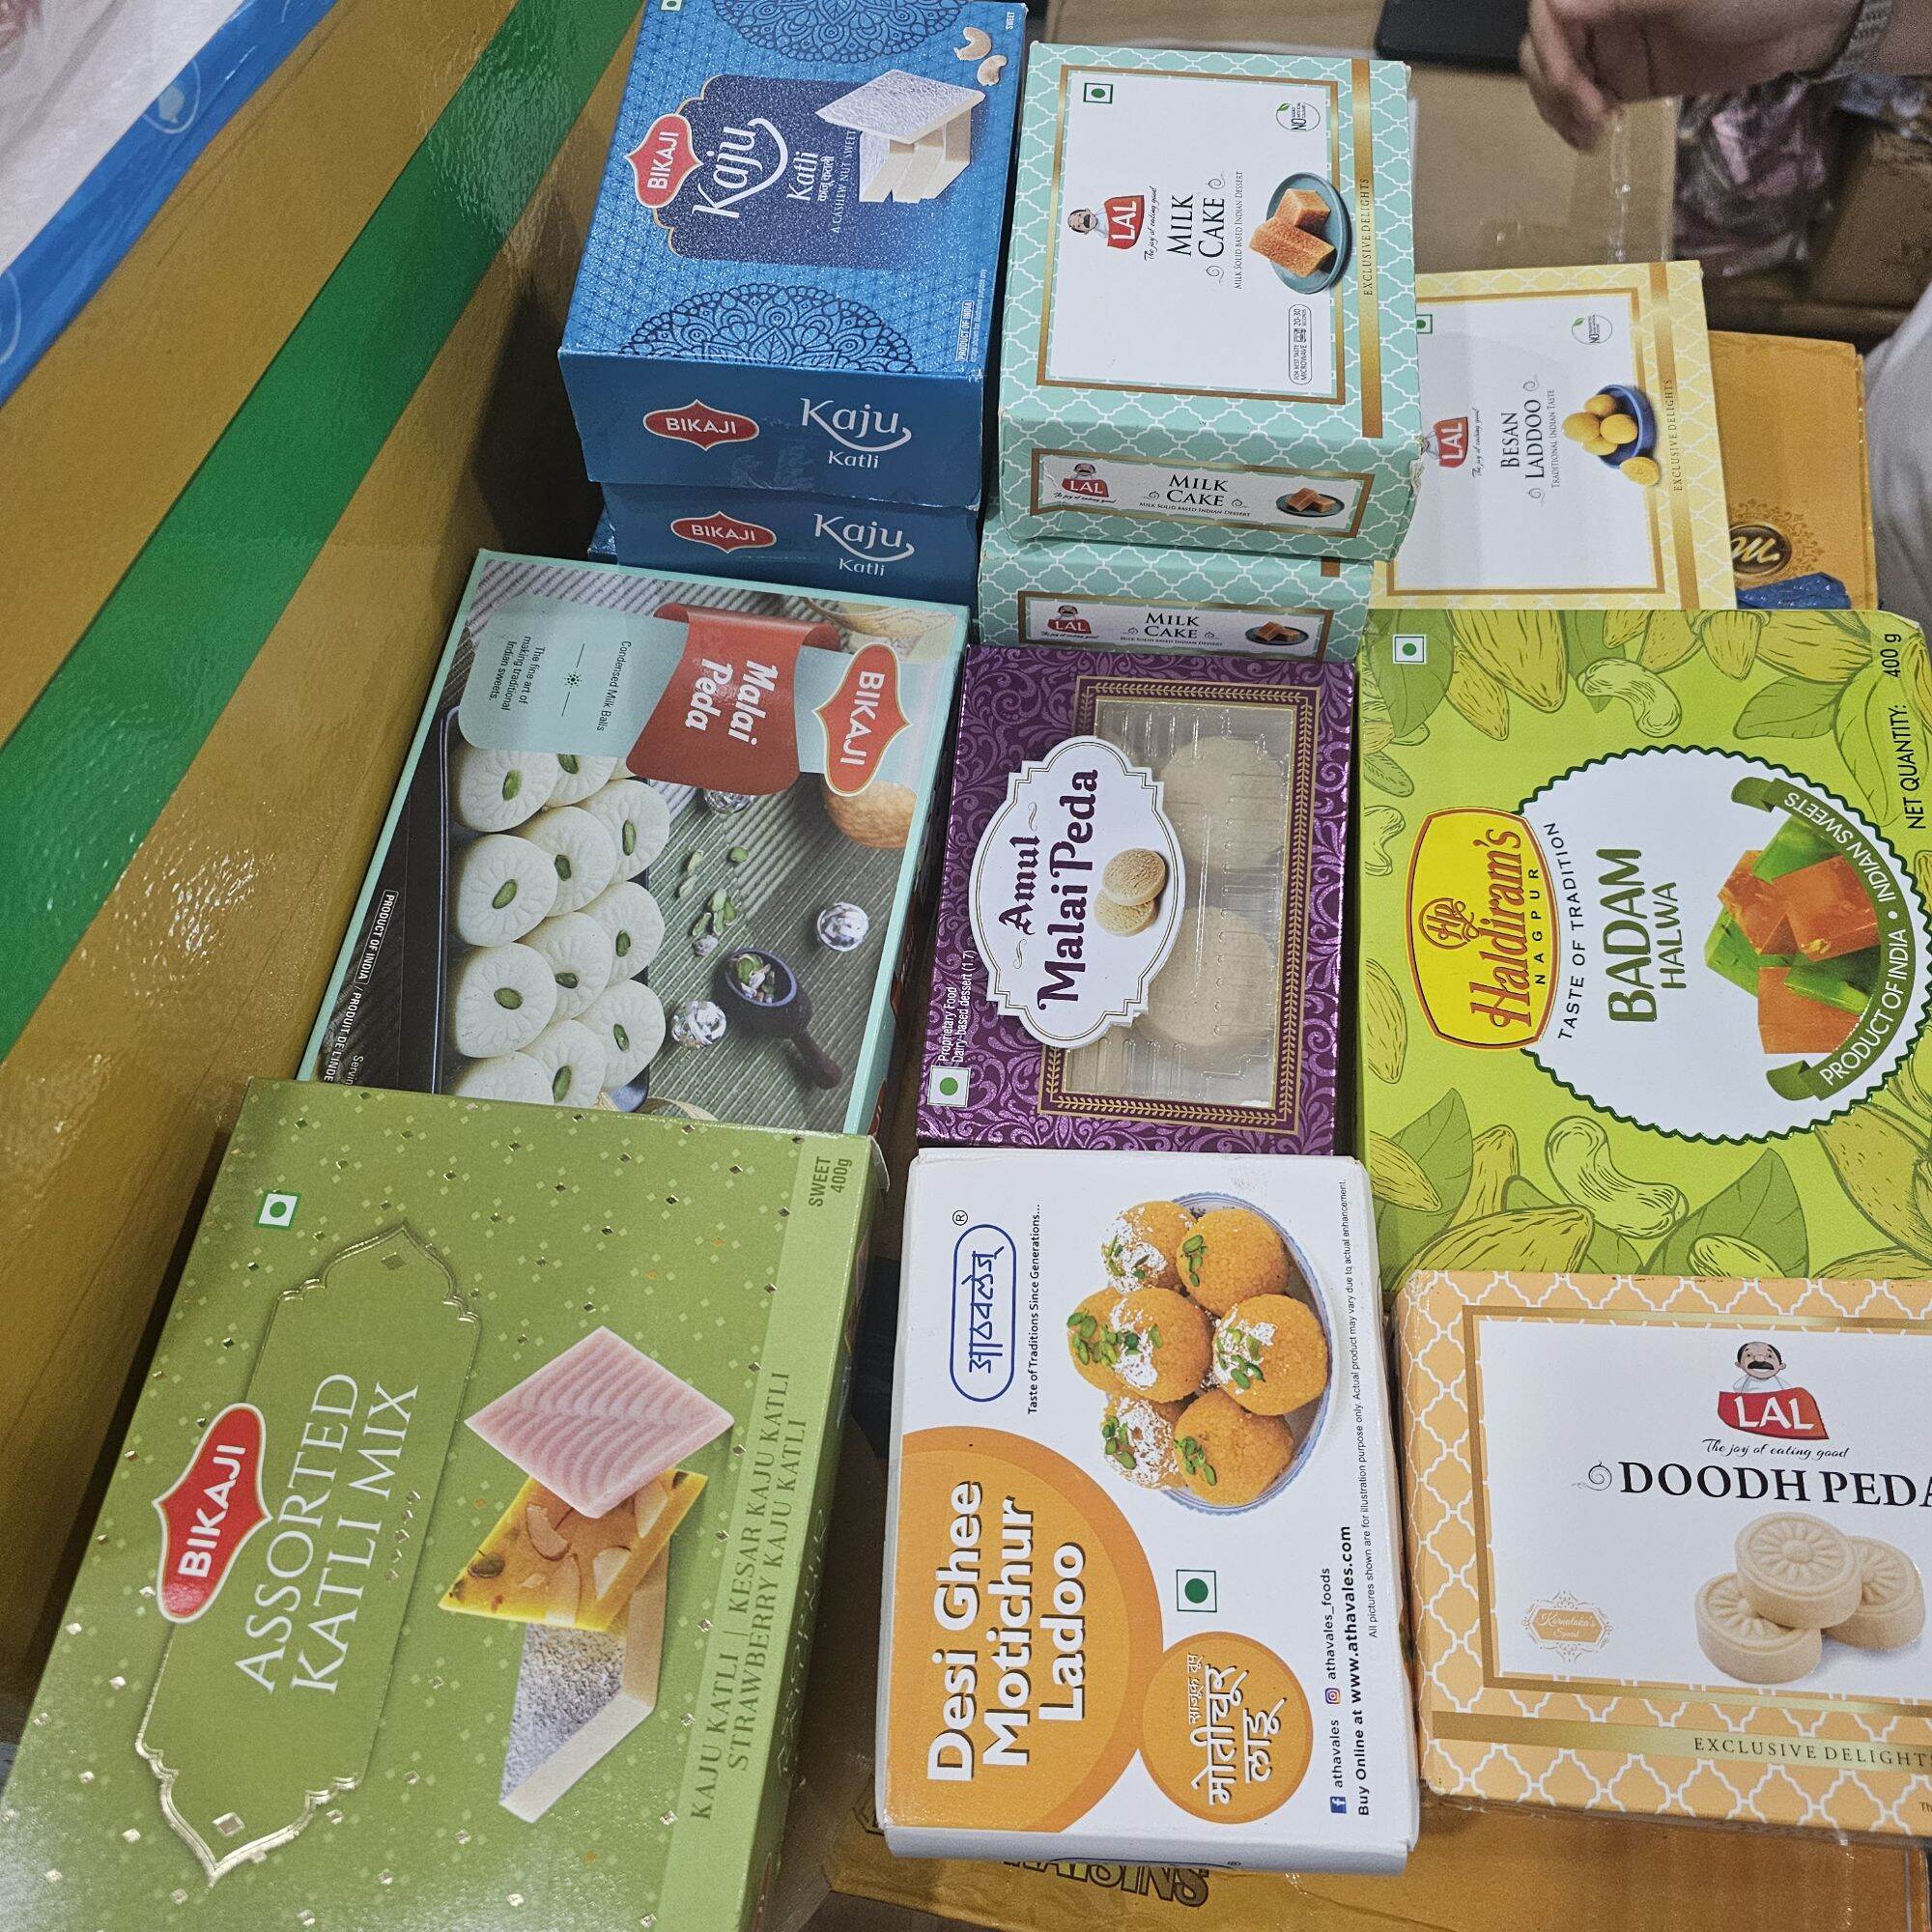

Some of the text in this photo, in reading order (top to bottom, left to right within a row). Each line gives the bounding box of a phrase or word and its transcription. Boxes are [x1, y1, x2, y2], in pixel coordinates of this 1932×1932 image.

[647, 131, 678, 189] BIKAJI
[843, 129, 856, 158] SWEET
[692, 118, 788, 218] Kaju
[786, 152, 818, 201] Katli
[840, 162, 850, 182] NUT
[833, 185, 846, 223] CASHEW
[1112, 201, 1137, 240] LAL
[1166, 194, 1193, 257] MILK
[1198, 197, 1224, 257] CAKE
[1359, 178, 1374, 296] EXCLUSIVE DELIGHTS
[962, 301, 972, 319] INDIA
[957, 330, 968, 359] PRODUCT
[666, 417, 736, 434] BIKAJI
[800, 398, 912, 452] Kaju
[1441, 423, 1463, 459] LAL
[1501, 412, 1520, 468] BESAN
[1524, 400, 1544, 478] LADDOO
[1548, 412, 1557, 439] INDIAN
[1662, 379, 1683, 491] EXCLUSIVE DELIGHTS
[829, 451, 879, 469] Katli
[1169, 473, 1229, 493] MILK
[1549, 440, 1559, 488] TRADITIONAL
[1070, 481, 1103, 495] LAL
[1167, 489, 1225, 506] CAKE
[692, 525, 755, 541] BIKAJI
[812, 514, 914, 562] Kaju
[839, 558, 885, 576] Katli
[1055, 621, 1086, 632] LAL
[1145, 626, 1198, 639] CAKE
[1146, 612, 1200, 627] MILK
[489, 641, 517, 701] Indian sweets.
[501, 636, 531, 711] making traditional
[519, 647, 546, 704] The fine art of
[1880, 634, 1901, 678] 400 g
[597, 641, 632, 730] Condensed Milk Balls
[684, 659, 732, 730] Peda
[728, 661, 778, 745] Malai
[840, 671, 885, 765] BIKAJI
[1888, 705, 1926, 829] NET QUANTITY:
[998, 836, 1040, 935] Amul
[1037, 769, 1097, 1010] Malai Peda
[373, 895, 394, 937] PRODUCT
[1468, 829, 1532, 1028] Haldiram's
[1527, 869, 1546, 984] NAGPUR
[1544, 823, 1585, 1039] TASTE OF TRADITION
[1596, 849, 1657, 1022] BADAM
[1652, 882, 1687, 989] HALWA
[1785, 792, 1909, 1086] PRODUCT OF INDIA INDIAN SWEETS
[358, 952, 375, 980] INDIA
[369, 939, 379, 951] OF
[340, 993, 361, 1034] PRODUIT
[937, 987, 956, 1062] Proprietary Food
[951, 974, 972, 1063] Dairy-based dessert
[334, 1036, 348, 1048] DE
[809, 1156, 831, 1207] SWEET
[831, 1158, 852, 1193] 400g
[1339, 1179, 1350, 1236] enhancement.
[1342, 1238, 1352, 1264] actual
[1345, 1265, 1352, 1275] to
[1028, 1204, 1040, 1414] Taste of Traditions Since Generations...
[1345, 1277, 1354, 1293] due
[1347, 1295, 1356, 1314] vary
[1349, 1316, 1357, 1335] may
[1349, 1337, 1360, 1370] product
[1350, 1372, 1360, 1400] Actual
[1735, 1396, 1814, 1430] LAL
[1355, 1426, 1367, 1463] purpose
[1702, 1438, 1849, 1461] The joy of eating good
[1358, 1464, 1368, 1513] illustration
[1618, 1461, 1809, 1502] DOODH
[178, 1445, 245, 1577] BIKAJI
[235, 1374, 357, 1693] ASSORTED
[1360, 1515, 1370, 1528] for
[291, 1381, 418, 1694] KATLI MIX
[1362, 1531, 1372, 1546] are
[1364, 1549, 1374, 1580] shown
[691, 1372, 789, 1820] KAJU KATLI KESAR KAJU KATLI
[727, 1577, 779, 1771] STRAWBERRY
[762, 1500, 792, 1568] KAJU
[777, 1419, 807, 1492] KATLI
[1366, 1584, 1378, 1623] pictures
[926, 1481, 982, 1781] Desi Ghee
[981, 1497, 1033, 1766] Motichur
[1038, 1543, 1086, 1720] Ladoo
[1368, 1625, 1378, 1638] All
[1321, 1568, 1343, 1787] athavales athavales_foods
[1339, 1526, 1370, 1816] Buy Online at www.athavales.com
[1189, 1664, 1248, 1804] मोतीचूर
[1242, 1698, 1286, 1783] लाडू
[1694, 1737, 1932, 1768] EXCLUSIVE DELIGHT
